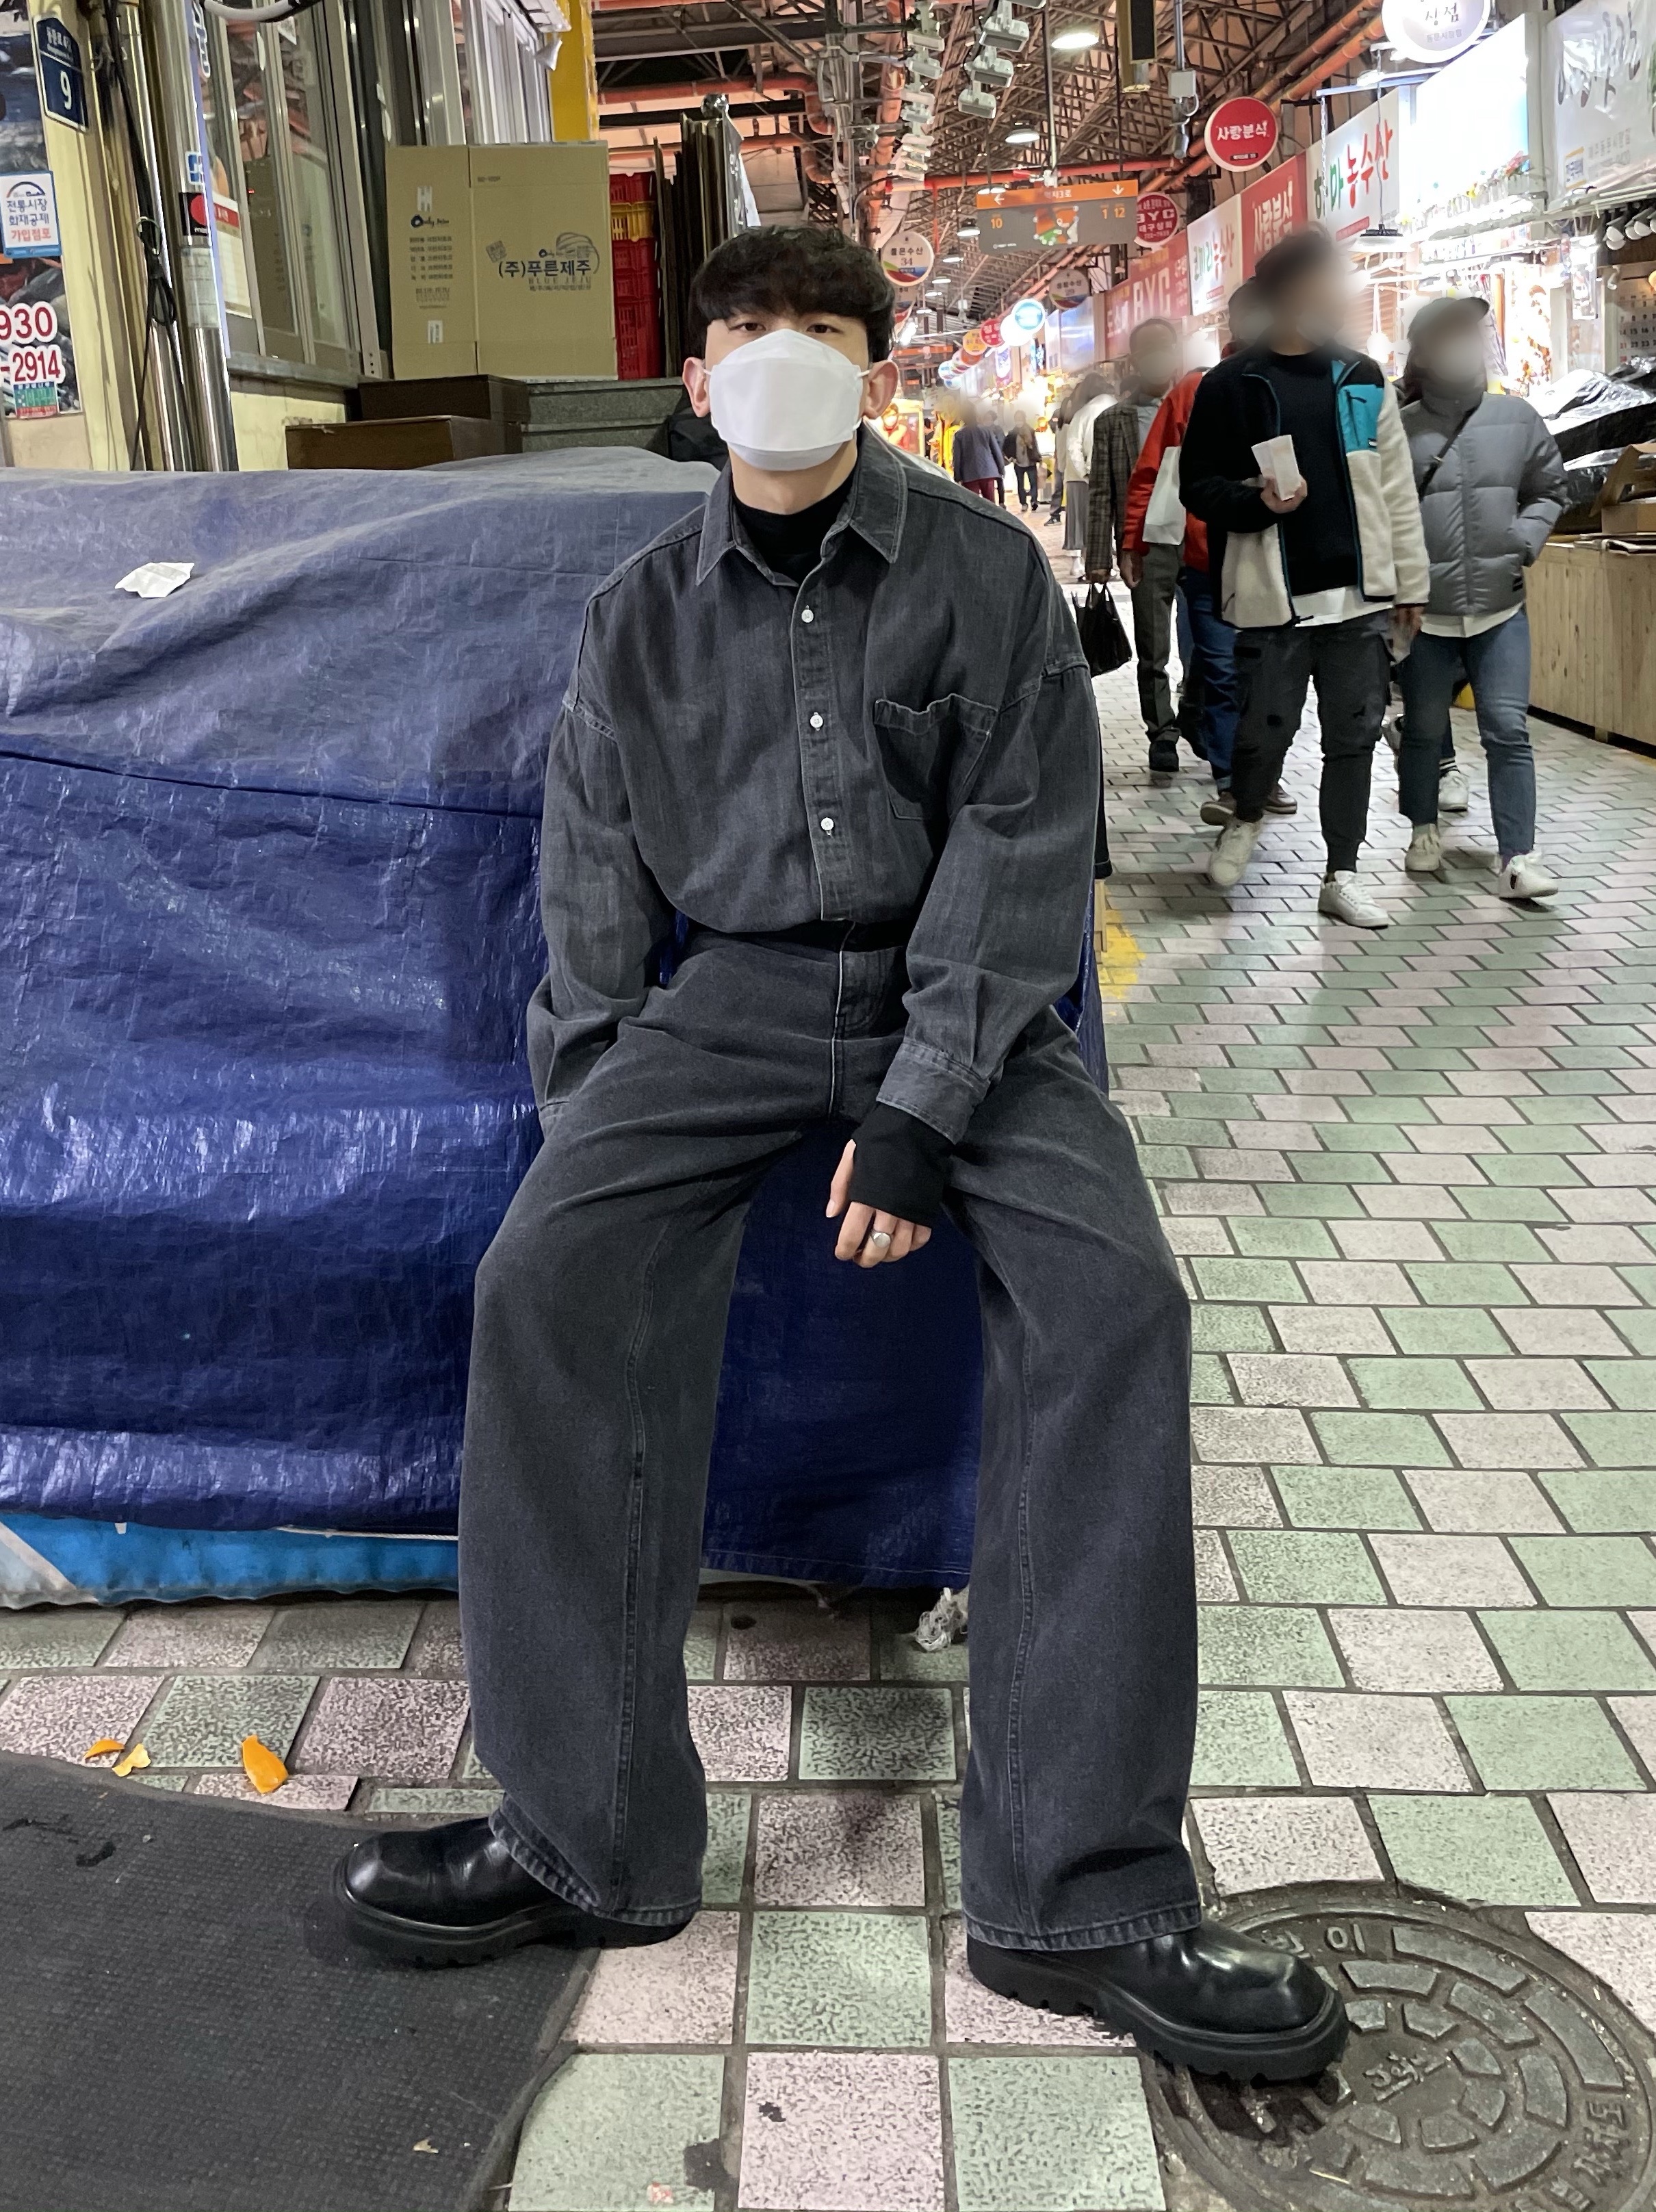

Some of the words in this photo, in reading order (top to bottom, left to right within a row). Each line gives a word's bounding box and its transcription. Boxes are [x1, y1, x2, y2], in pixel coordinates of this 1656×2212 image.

[60, 70, 72, 110] 9
[1217, 120, 1267, 141] 사랑분식
[6, 198, 48, 213] 전통시장
[1114, 207, 1126, 218] 12
[8, 212, 50, 227] 화재공제
[991, 218, 1003, 229] 10
[11, 227, 52, 243] 가입점포
[498, 259, 593, 279] (주)푸른제주
[1133, 266, 1172, 323] BYC
